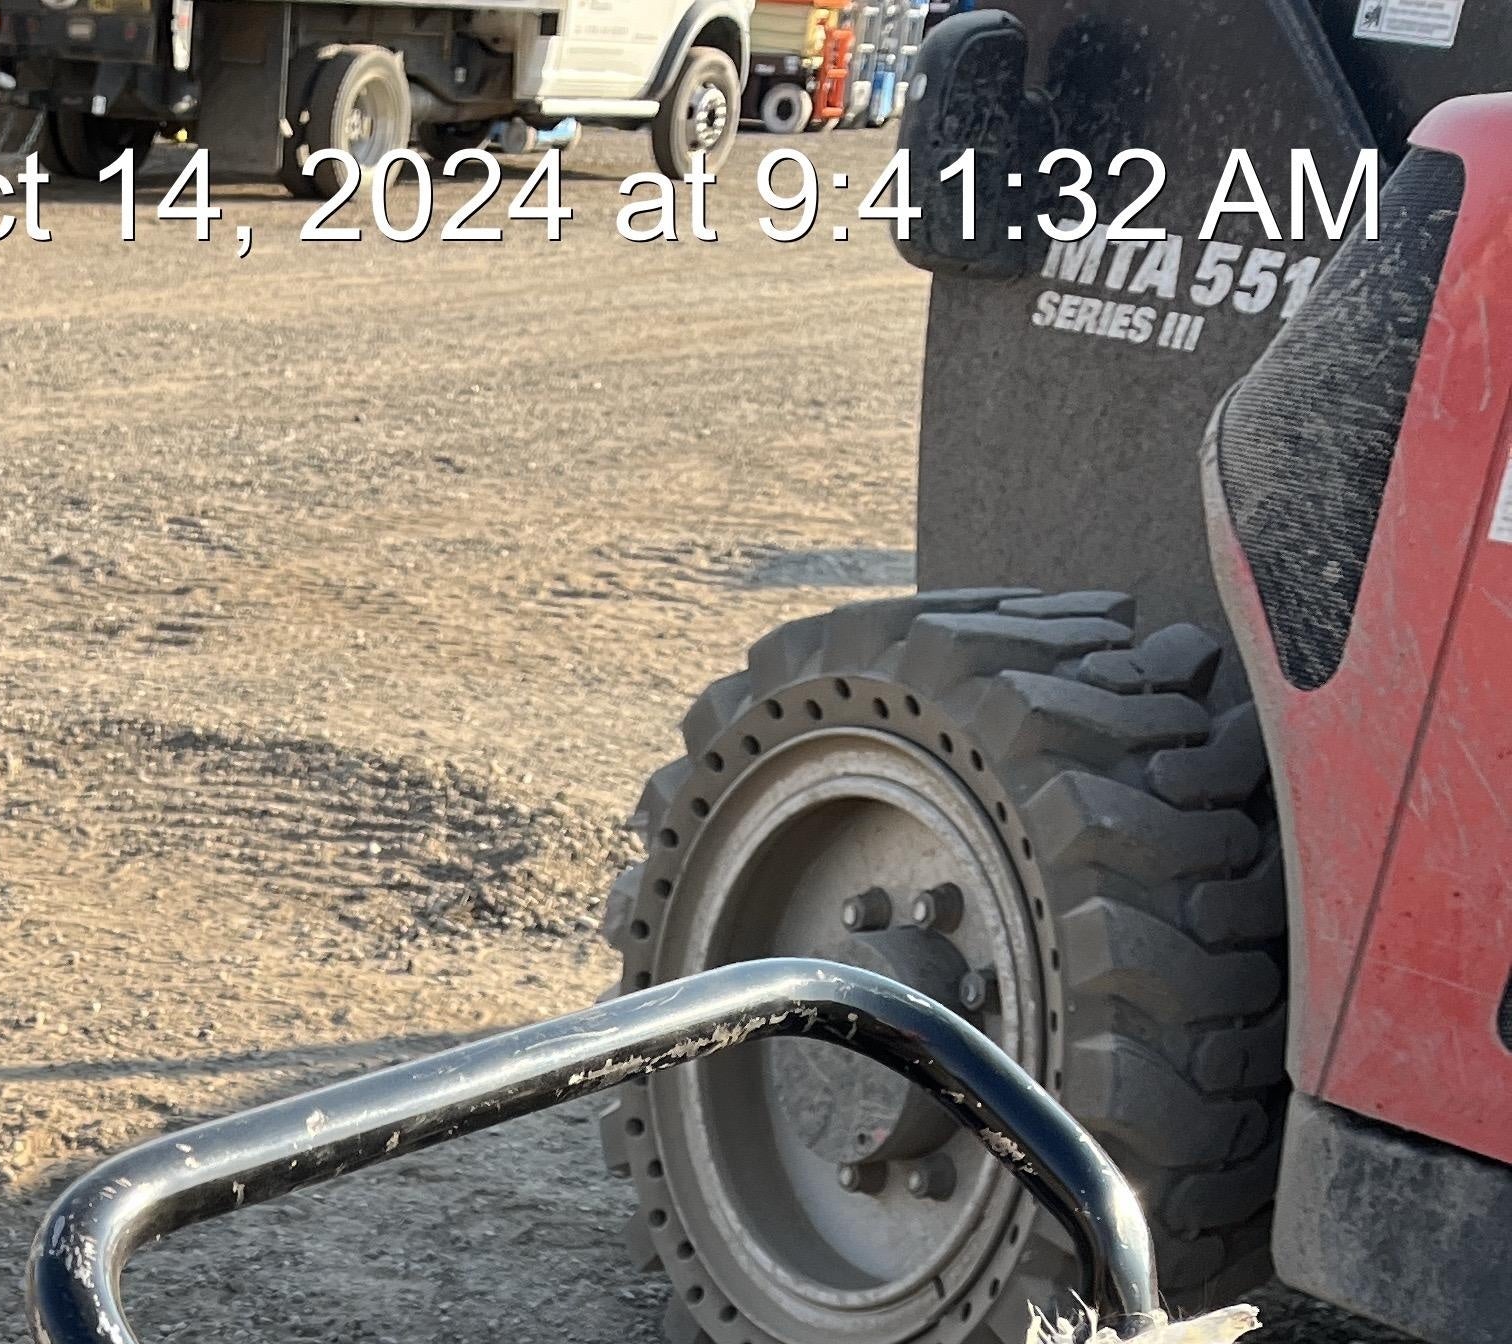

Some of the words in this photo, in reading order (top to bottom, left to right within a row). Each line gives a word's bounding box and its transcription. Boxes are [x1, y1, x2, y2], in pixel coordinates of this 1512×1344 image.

[1040, 217, 1184, 299] MTA
[1031, 289, 1158, 344] SERIES
[1157, 310, 1206, 351] III
